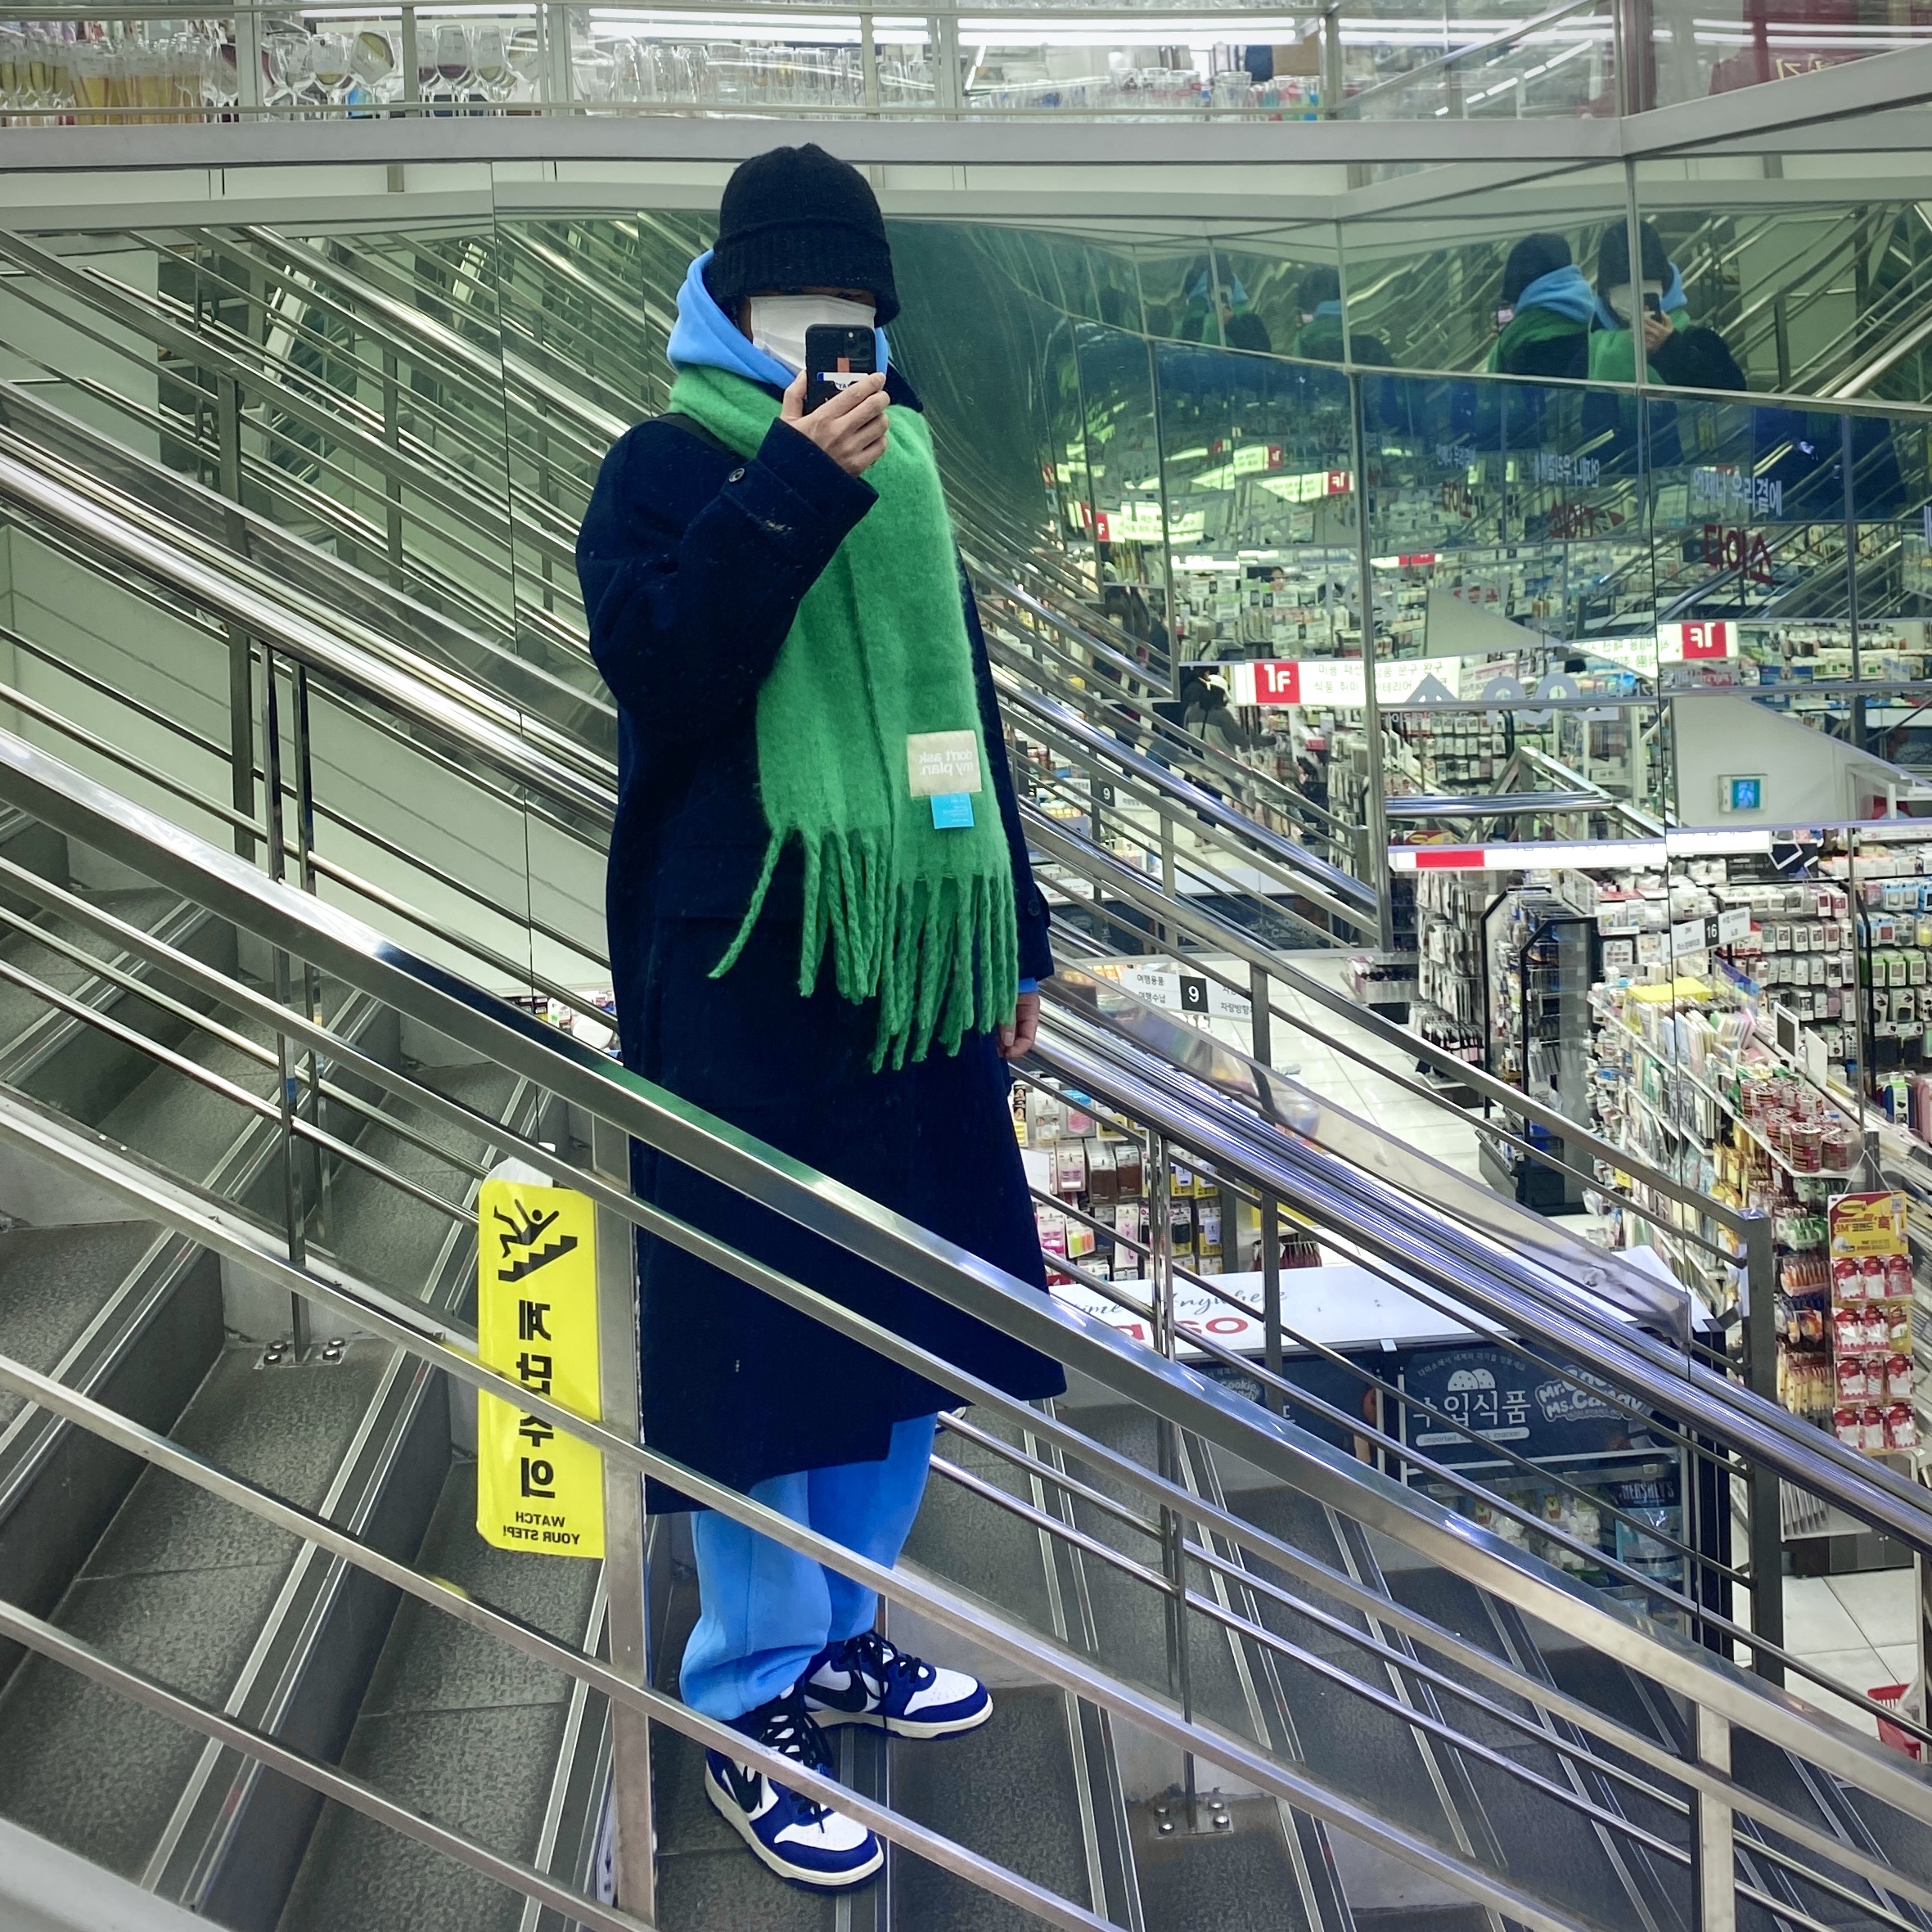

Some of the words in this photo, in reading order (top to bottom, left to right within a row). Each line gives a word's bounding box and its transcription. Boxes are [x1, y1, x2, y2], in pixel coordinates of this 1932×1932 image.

[1693, 466, 1727, 508] 언제나
[1704, 524, 1774, 585] 다이소
[1263, 664, 1291, 693] 1F
[1318, 664, 1337, 676] 미용
[1398, 664, 1418, 677] 문구
[1314, 680, 1334, 693] 식품
[1378, 680, 1412, 693] 테리어
[1102, 787, 1111, 800] 9
[1706, 923, 1718, 939] 16
[1137, 974, 1164, 986] 여행용품
[1188, 985, 1200, 1003] 9
[1220, 1002, 1251, 1015] 차량방향
[1538, 1382, 1565, 1403] Mr.
[1413, 1390, 1532, 1429] 수입식품
[1546, 1400, 1574, 1418] Ms.
